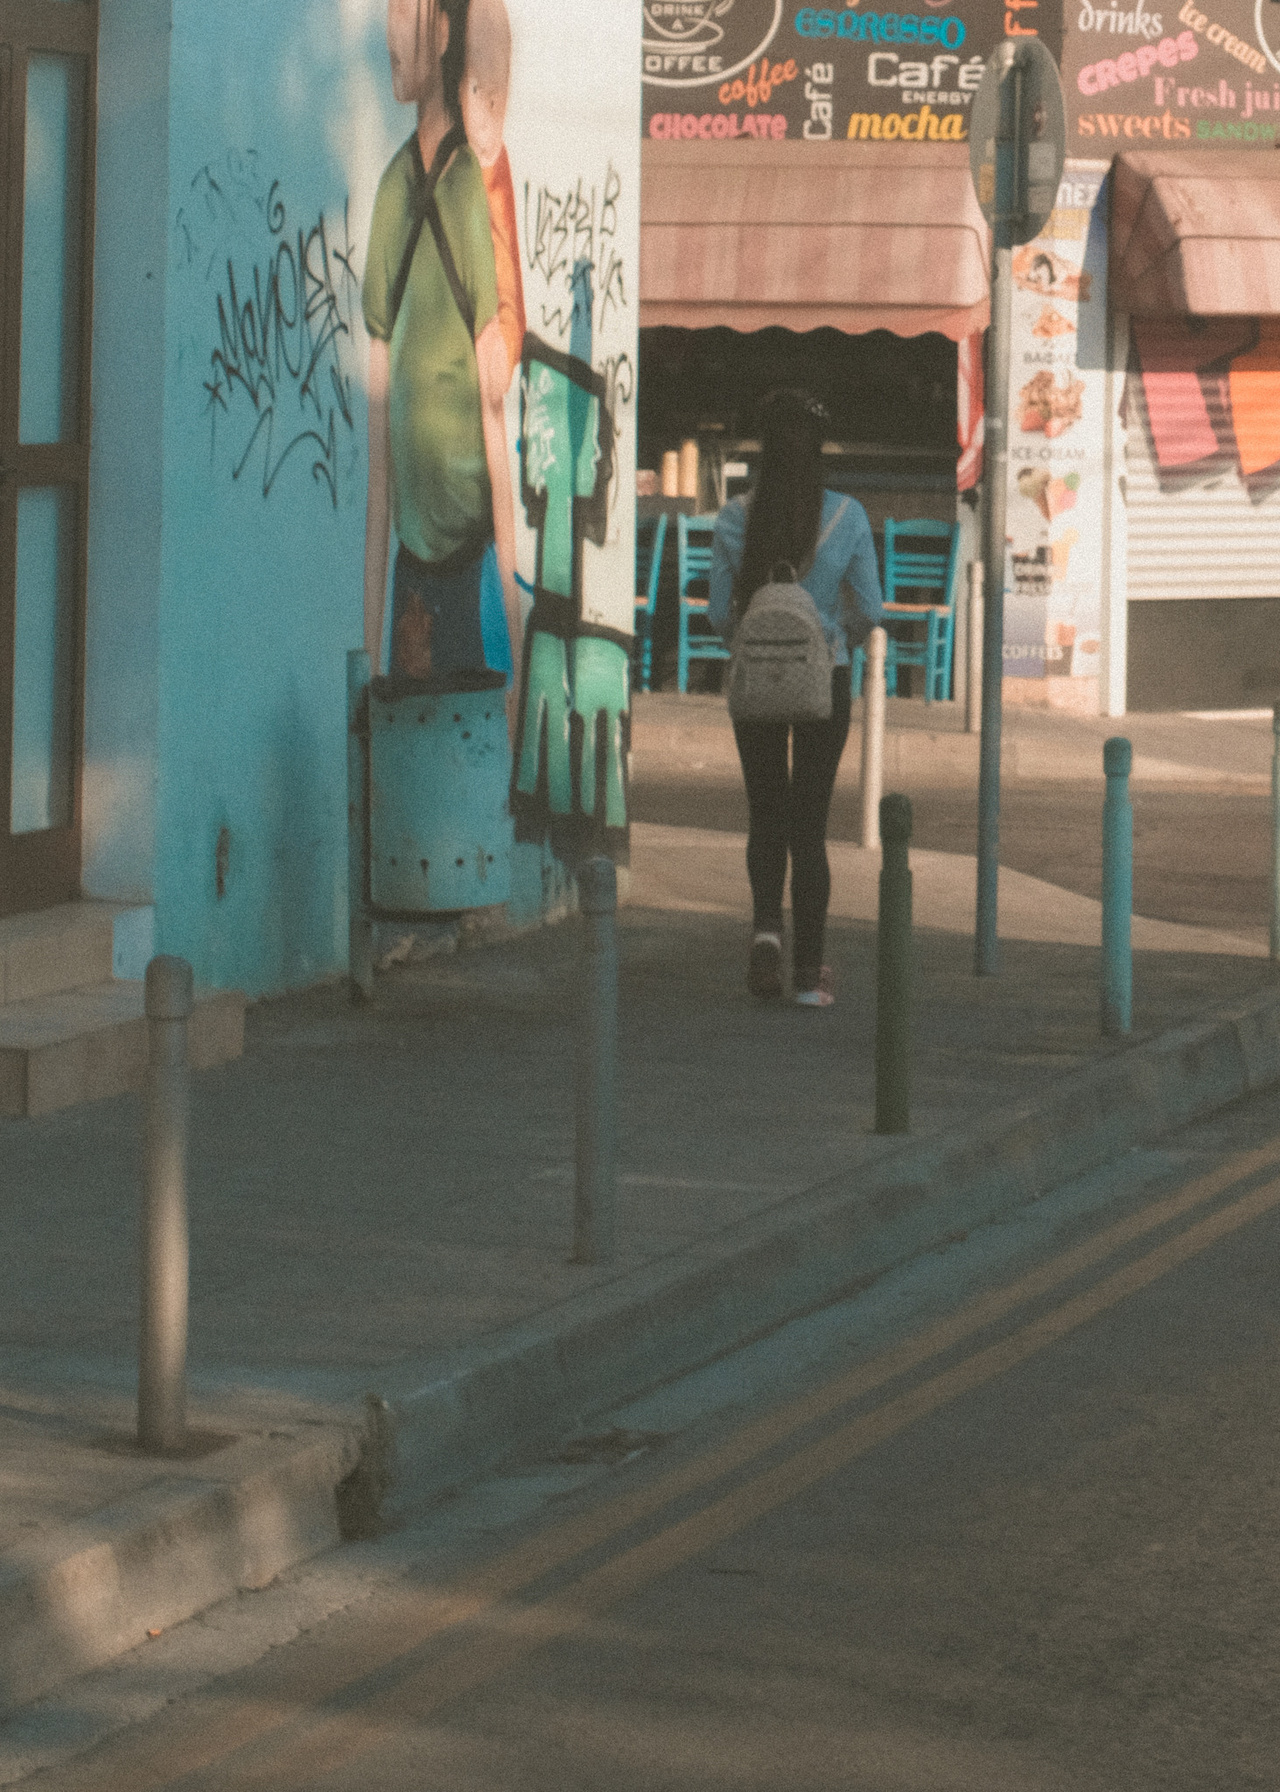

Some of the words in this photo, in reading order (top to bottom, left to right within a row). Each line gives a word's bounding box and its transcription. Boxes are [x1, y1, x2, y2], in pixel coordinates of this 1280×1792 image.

[651, 3, 704, 17] DRINK
[671, 18, 685, 31] A
[645, 54, 723, 72] OFFEE
[1205, 22, 1267, 75] cream
[718, 57, 801, 108] coffee
[901, 90, 975, 106] ENERGY
[1154, 76, 1237, 109] Fresh
[802, 61, 835, 141] Café
[847, 104, 969, 141] mocha
[1077, 108, 1192, 140] sweets
